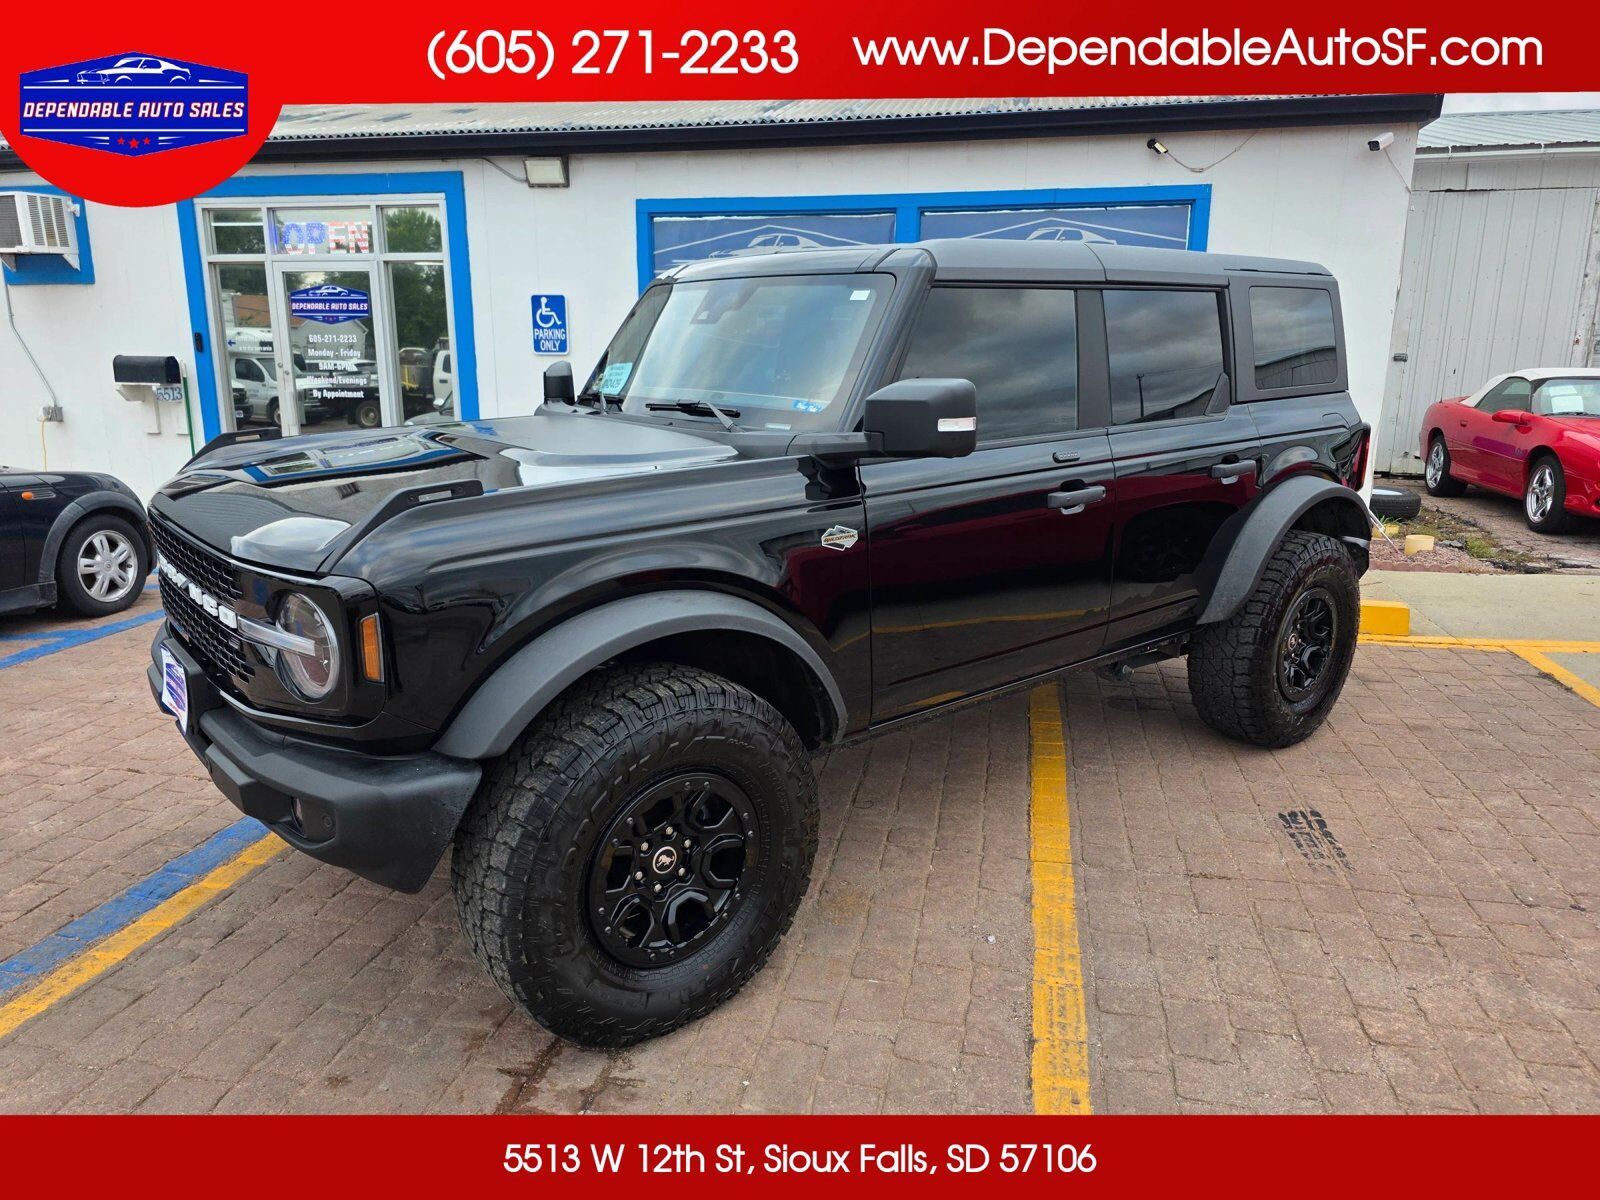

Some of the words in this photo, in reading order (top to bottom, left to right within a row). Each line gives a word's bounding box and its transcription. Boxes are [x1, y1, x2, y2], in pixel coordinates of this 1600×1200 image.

[282, 221, 369, 256] OPEN
[292, 302, 330, 310] DEPENDABLE
[330, 302, 348, 310] AUTO
[348, 302, 368, 310] SALES
[308, 334, 357, 343] 605-271-2233
[534, 328, 566, 340] PARKING
[540, 339, 561, 351] ONLY
[308, 348, 334, 358] Monday
[340, 348, 361, 358] Friday
[156, 387, 183, 401] 5513
[313, 389, 321, 399] By
[322, 389, 364, 399] Appointment
